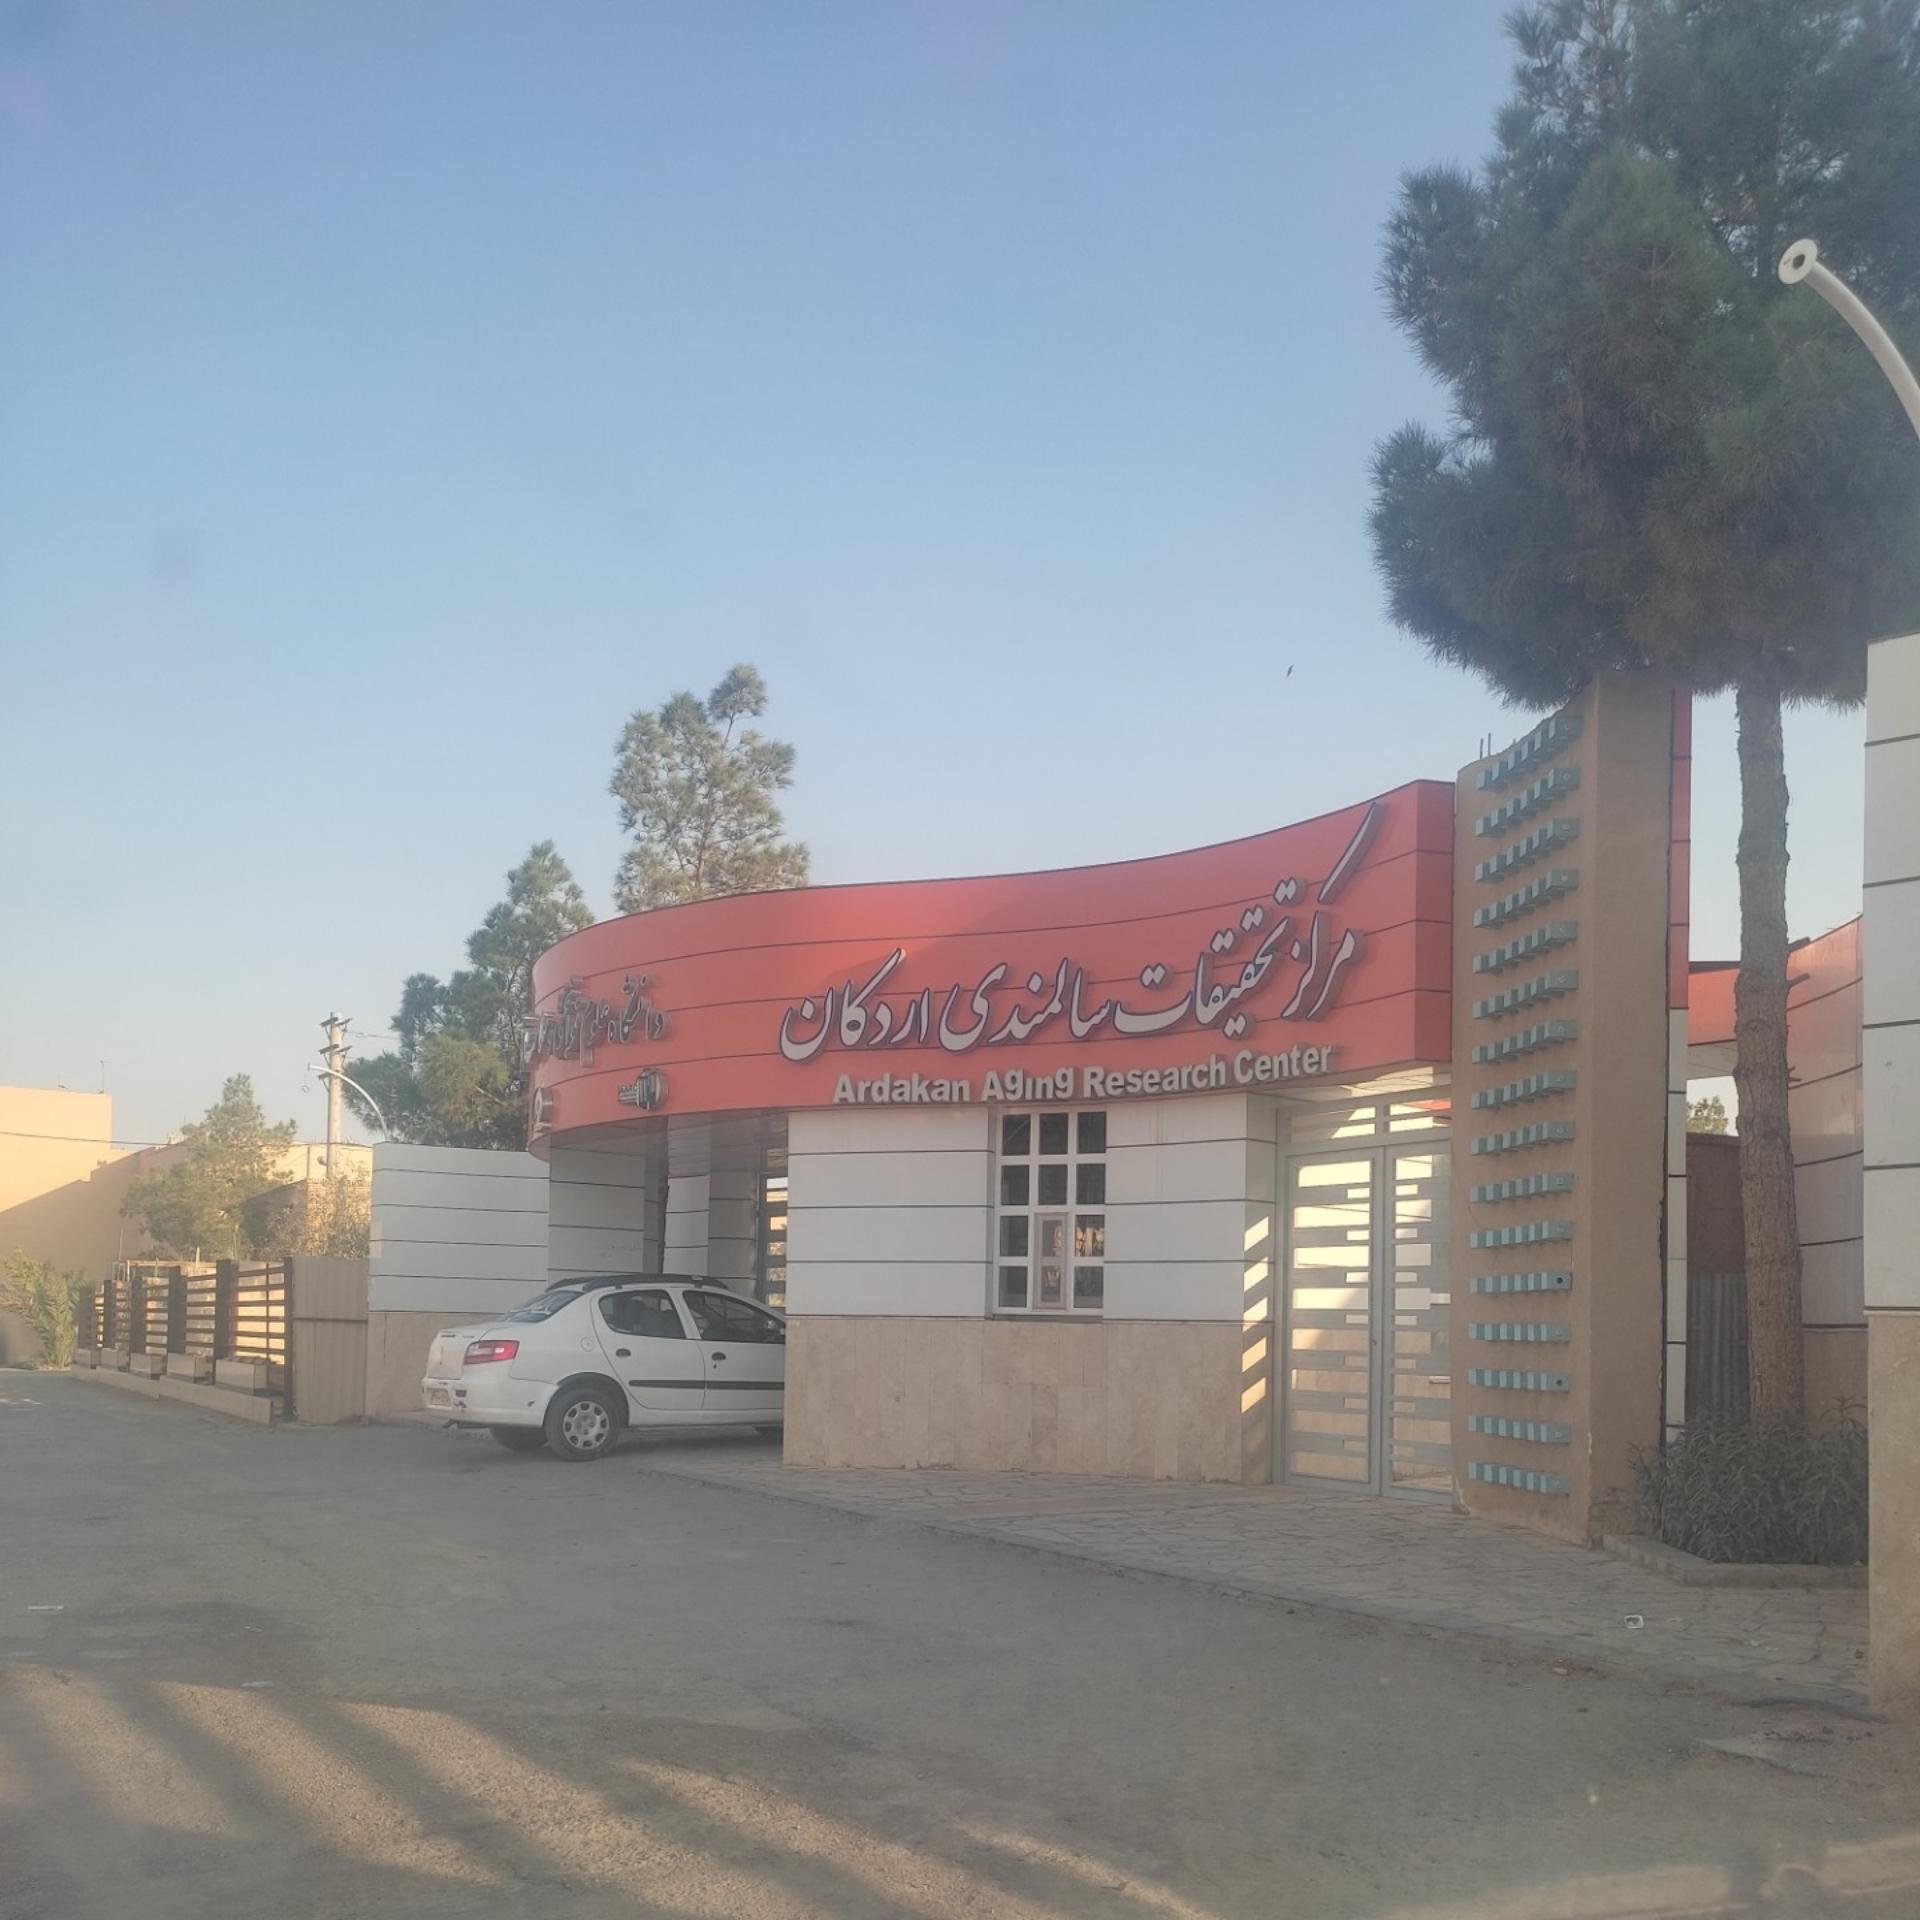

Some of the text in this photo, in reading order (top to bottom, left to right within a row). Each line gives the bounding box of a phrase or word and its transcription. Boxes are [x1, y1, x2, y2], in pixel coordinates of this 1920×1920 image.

[779, 947, 930, 1062] اردکان
[938, 957, 1112, 1053] سالمندی
[1113, 878, 1297, 1039] تحقیقات
[832, 1072, 970, 1104] Ardakan
[1083, 1058, 1226, 1098] Research
[1232, 1043, 1332, 1085] Center
